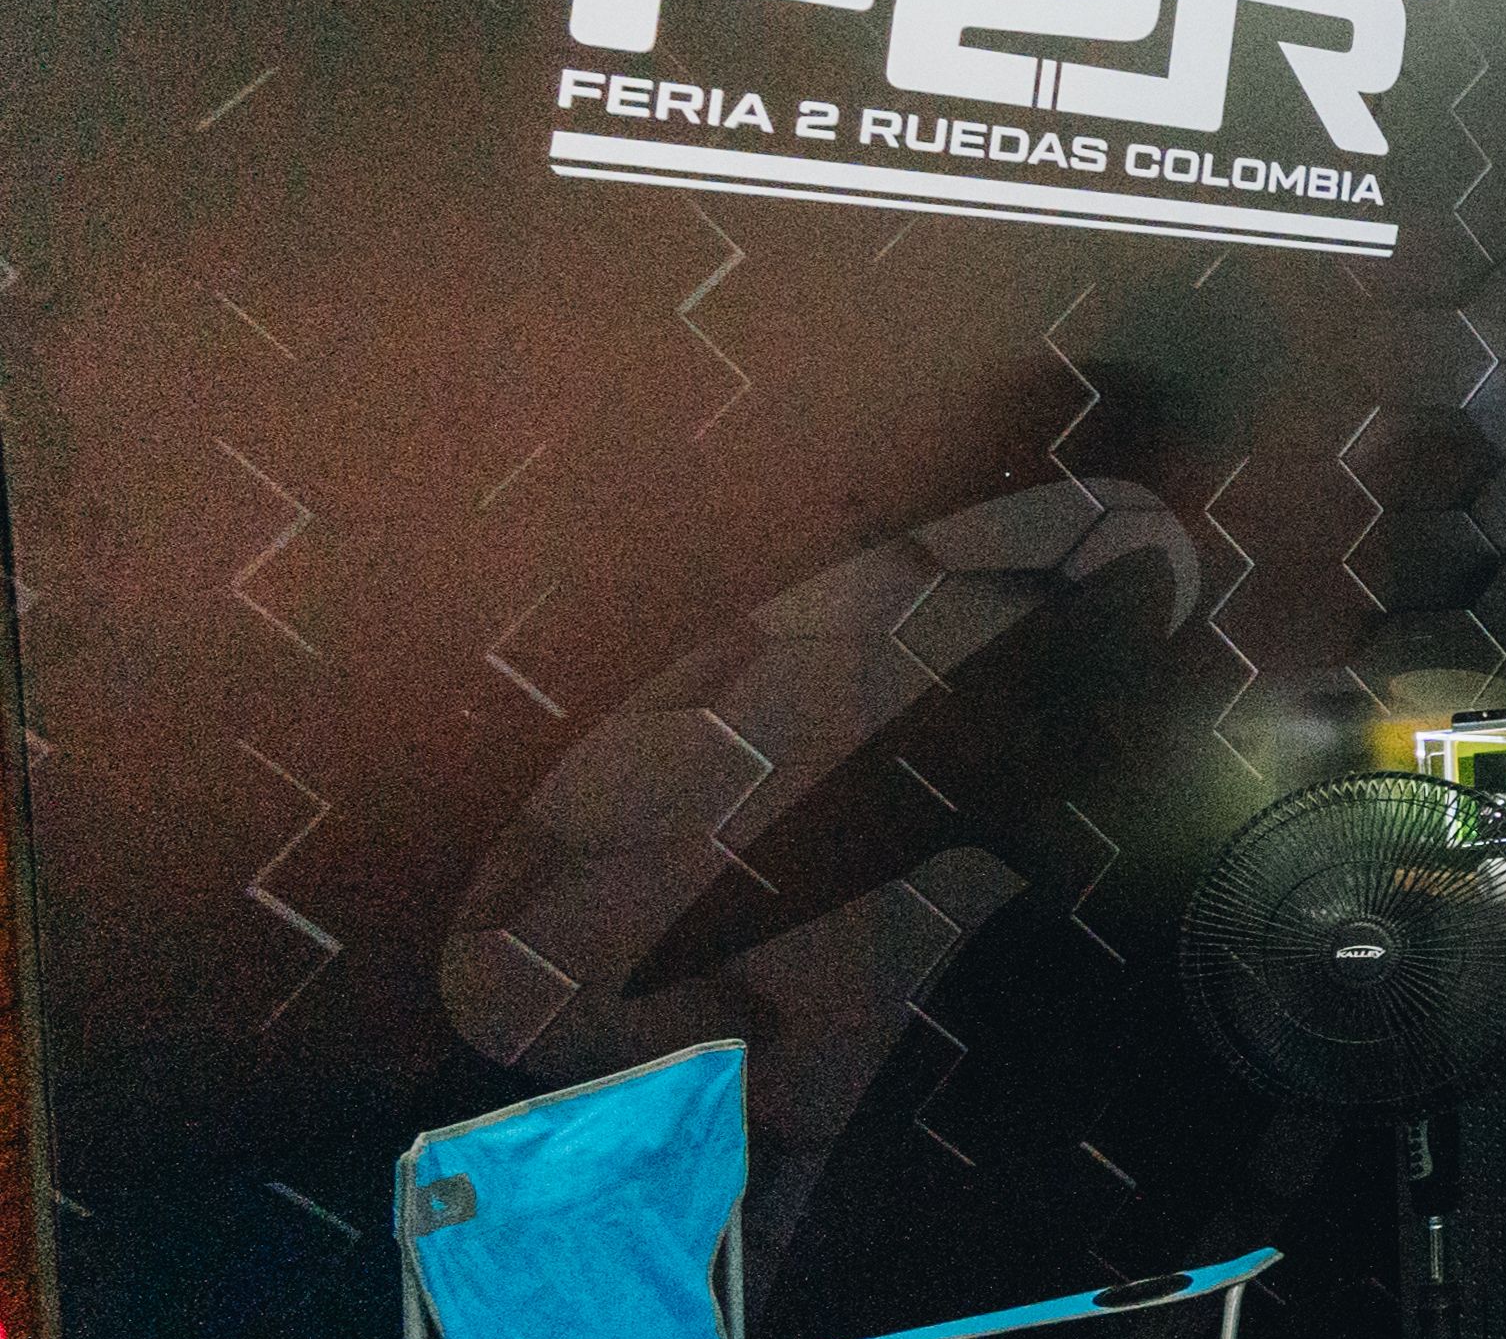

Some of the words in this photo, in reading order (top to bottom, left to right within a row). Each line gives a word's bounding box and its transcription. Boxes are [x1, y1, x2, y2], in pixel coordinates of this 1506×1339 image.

[557, 67, 774, 134] FERIA
[795, 99, 838, 142] 2
[859, 109, 1109, 172] RUEDAS
[1125, 142, 1385, 206] COLOMBIA
[1335, 947, 1387, 959] KALLEY
